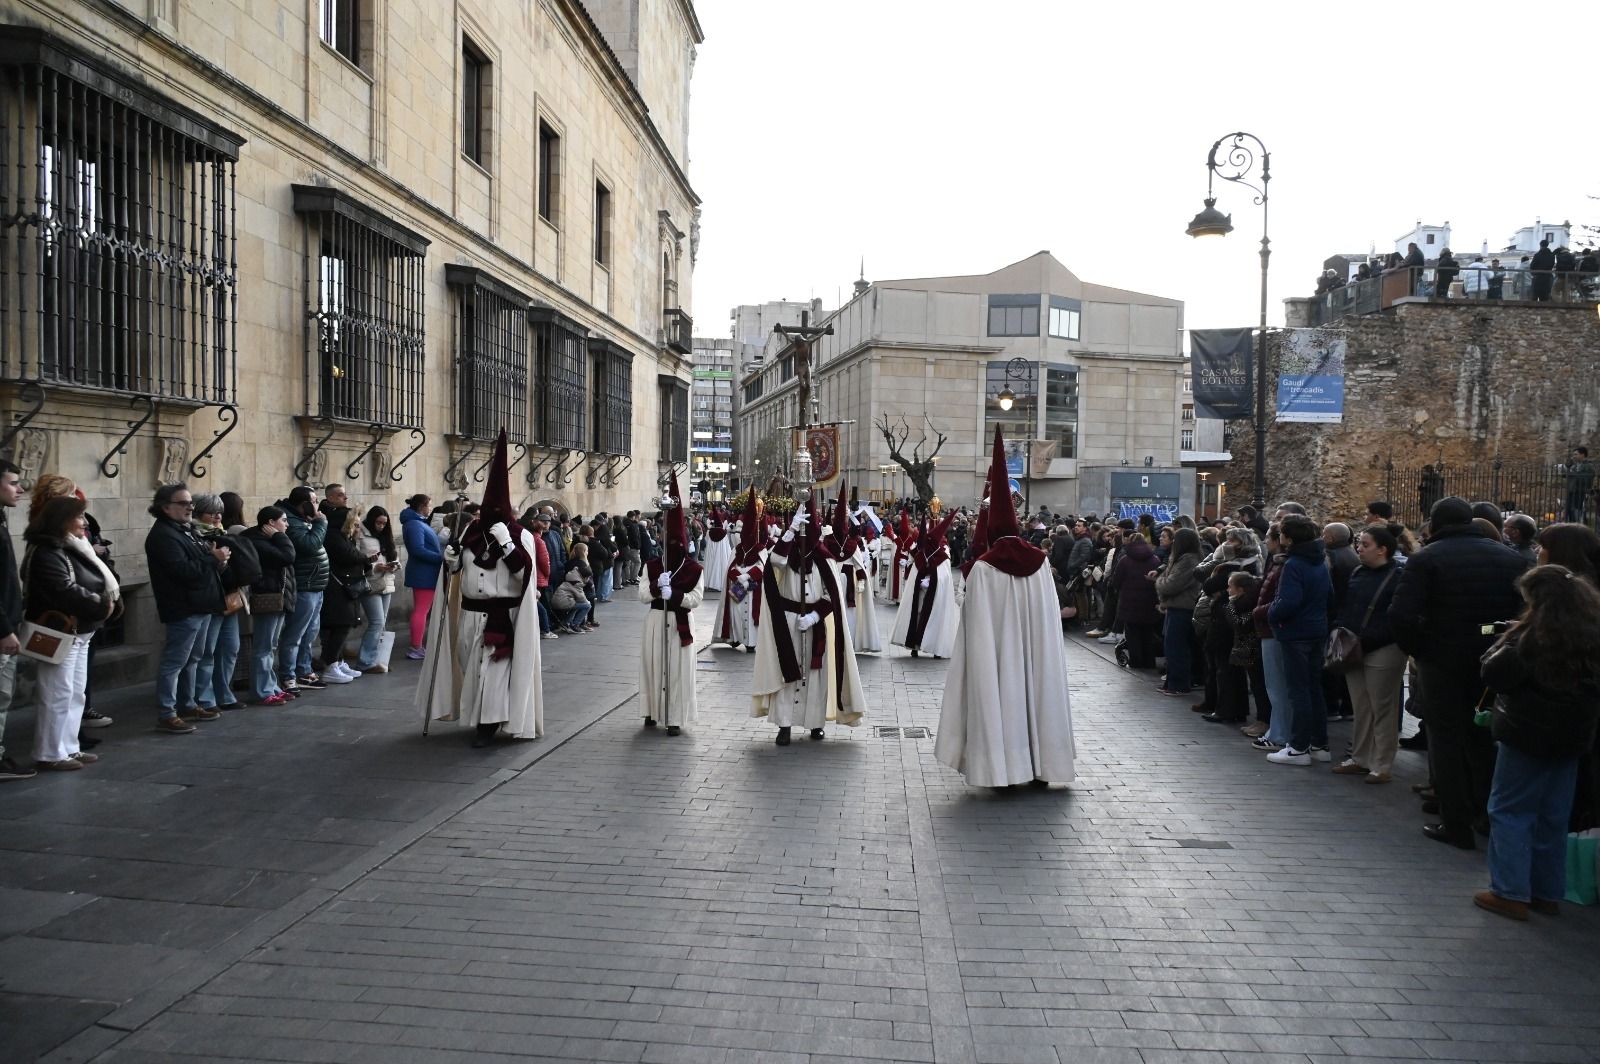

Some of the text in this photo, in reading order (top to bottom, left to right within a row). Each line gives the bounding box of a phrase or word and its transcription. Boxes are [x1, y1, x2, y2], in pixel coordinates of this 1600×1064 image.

[1201, 368, 1229, 377] CASA
[1202, 376, 1247, 385] BOTINES
[1282, 378, 1305, 387] Gaudí
